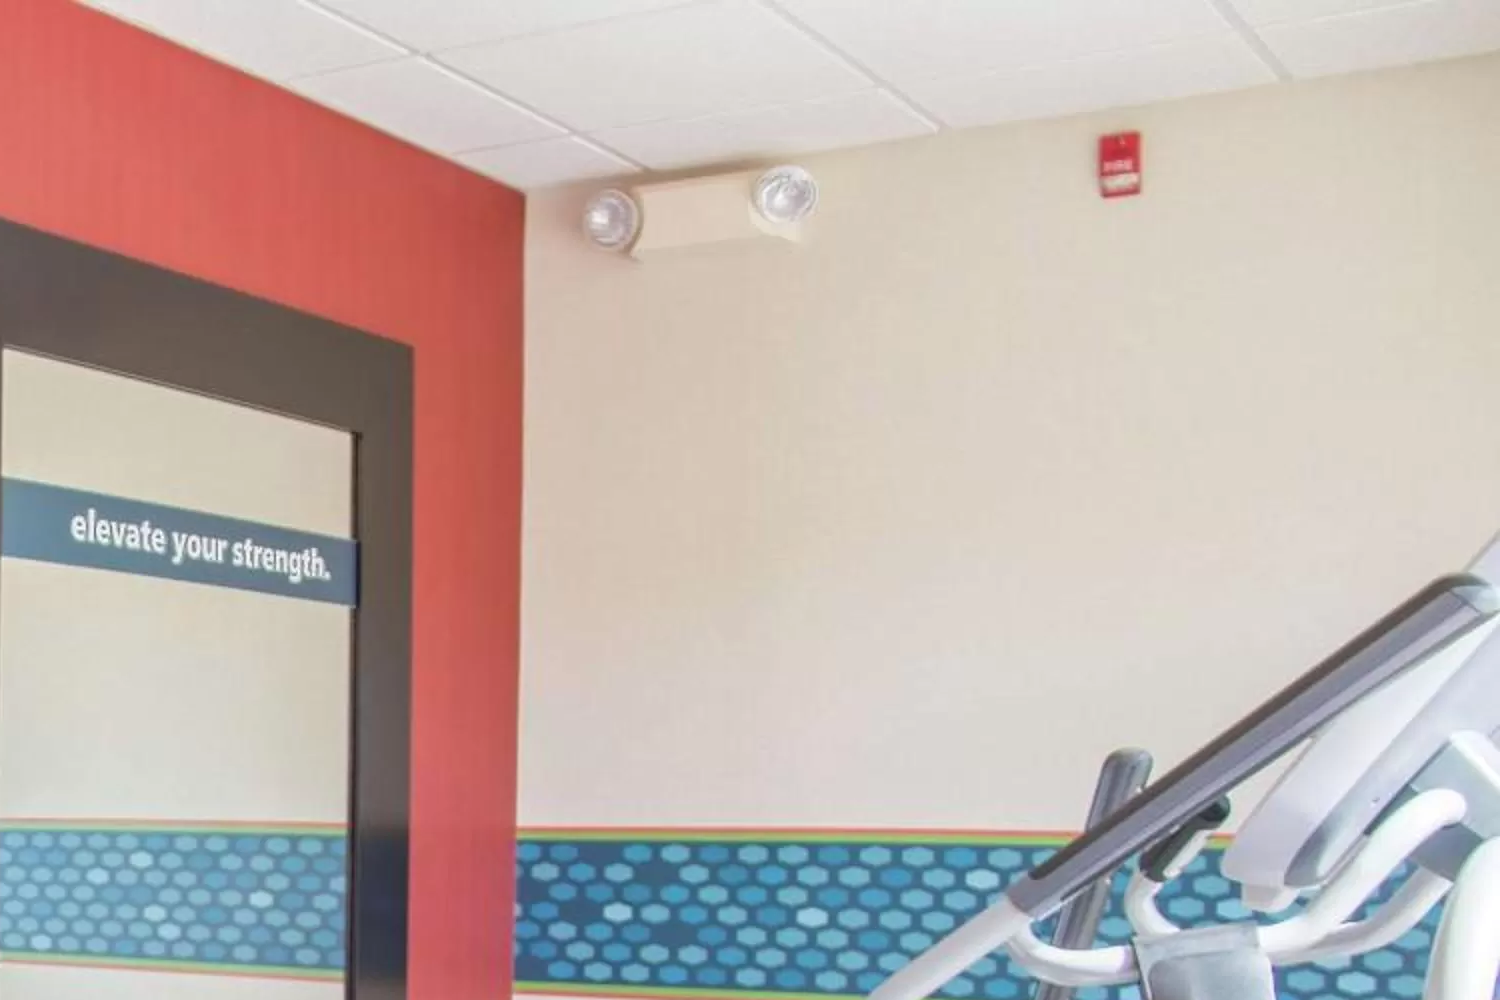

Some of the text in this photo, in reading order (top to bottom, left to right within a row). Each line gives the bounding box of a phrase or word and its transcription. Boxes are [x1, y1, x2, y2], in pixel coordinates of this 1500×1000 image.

[70, 508, 332, 585] elevate your strength.
